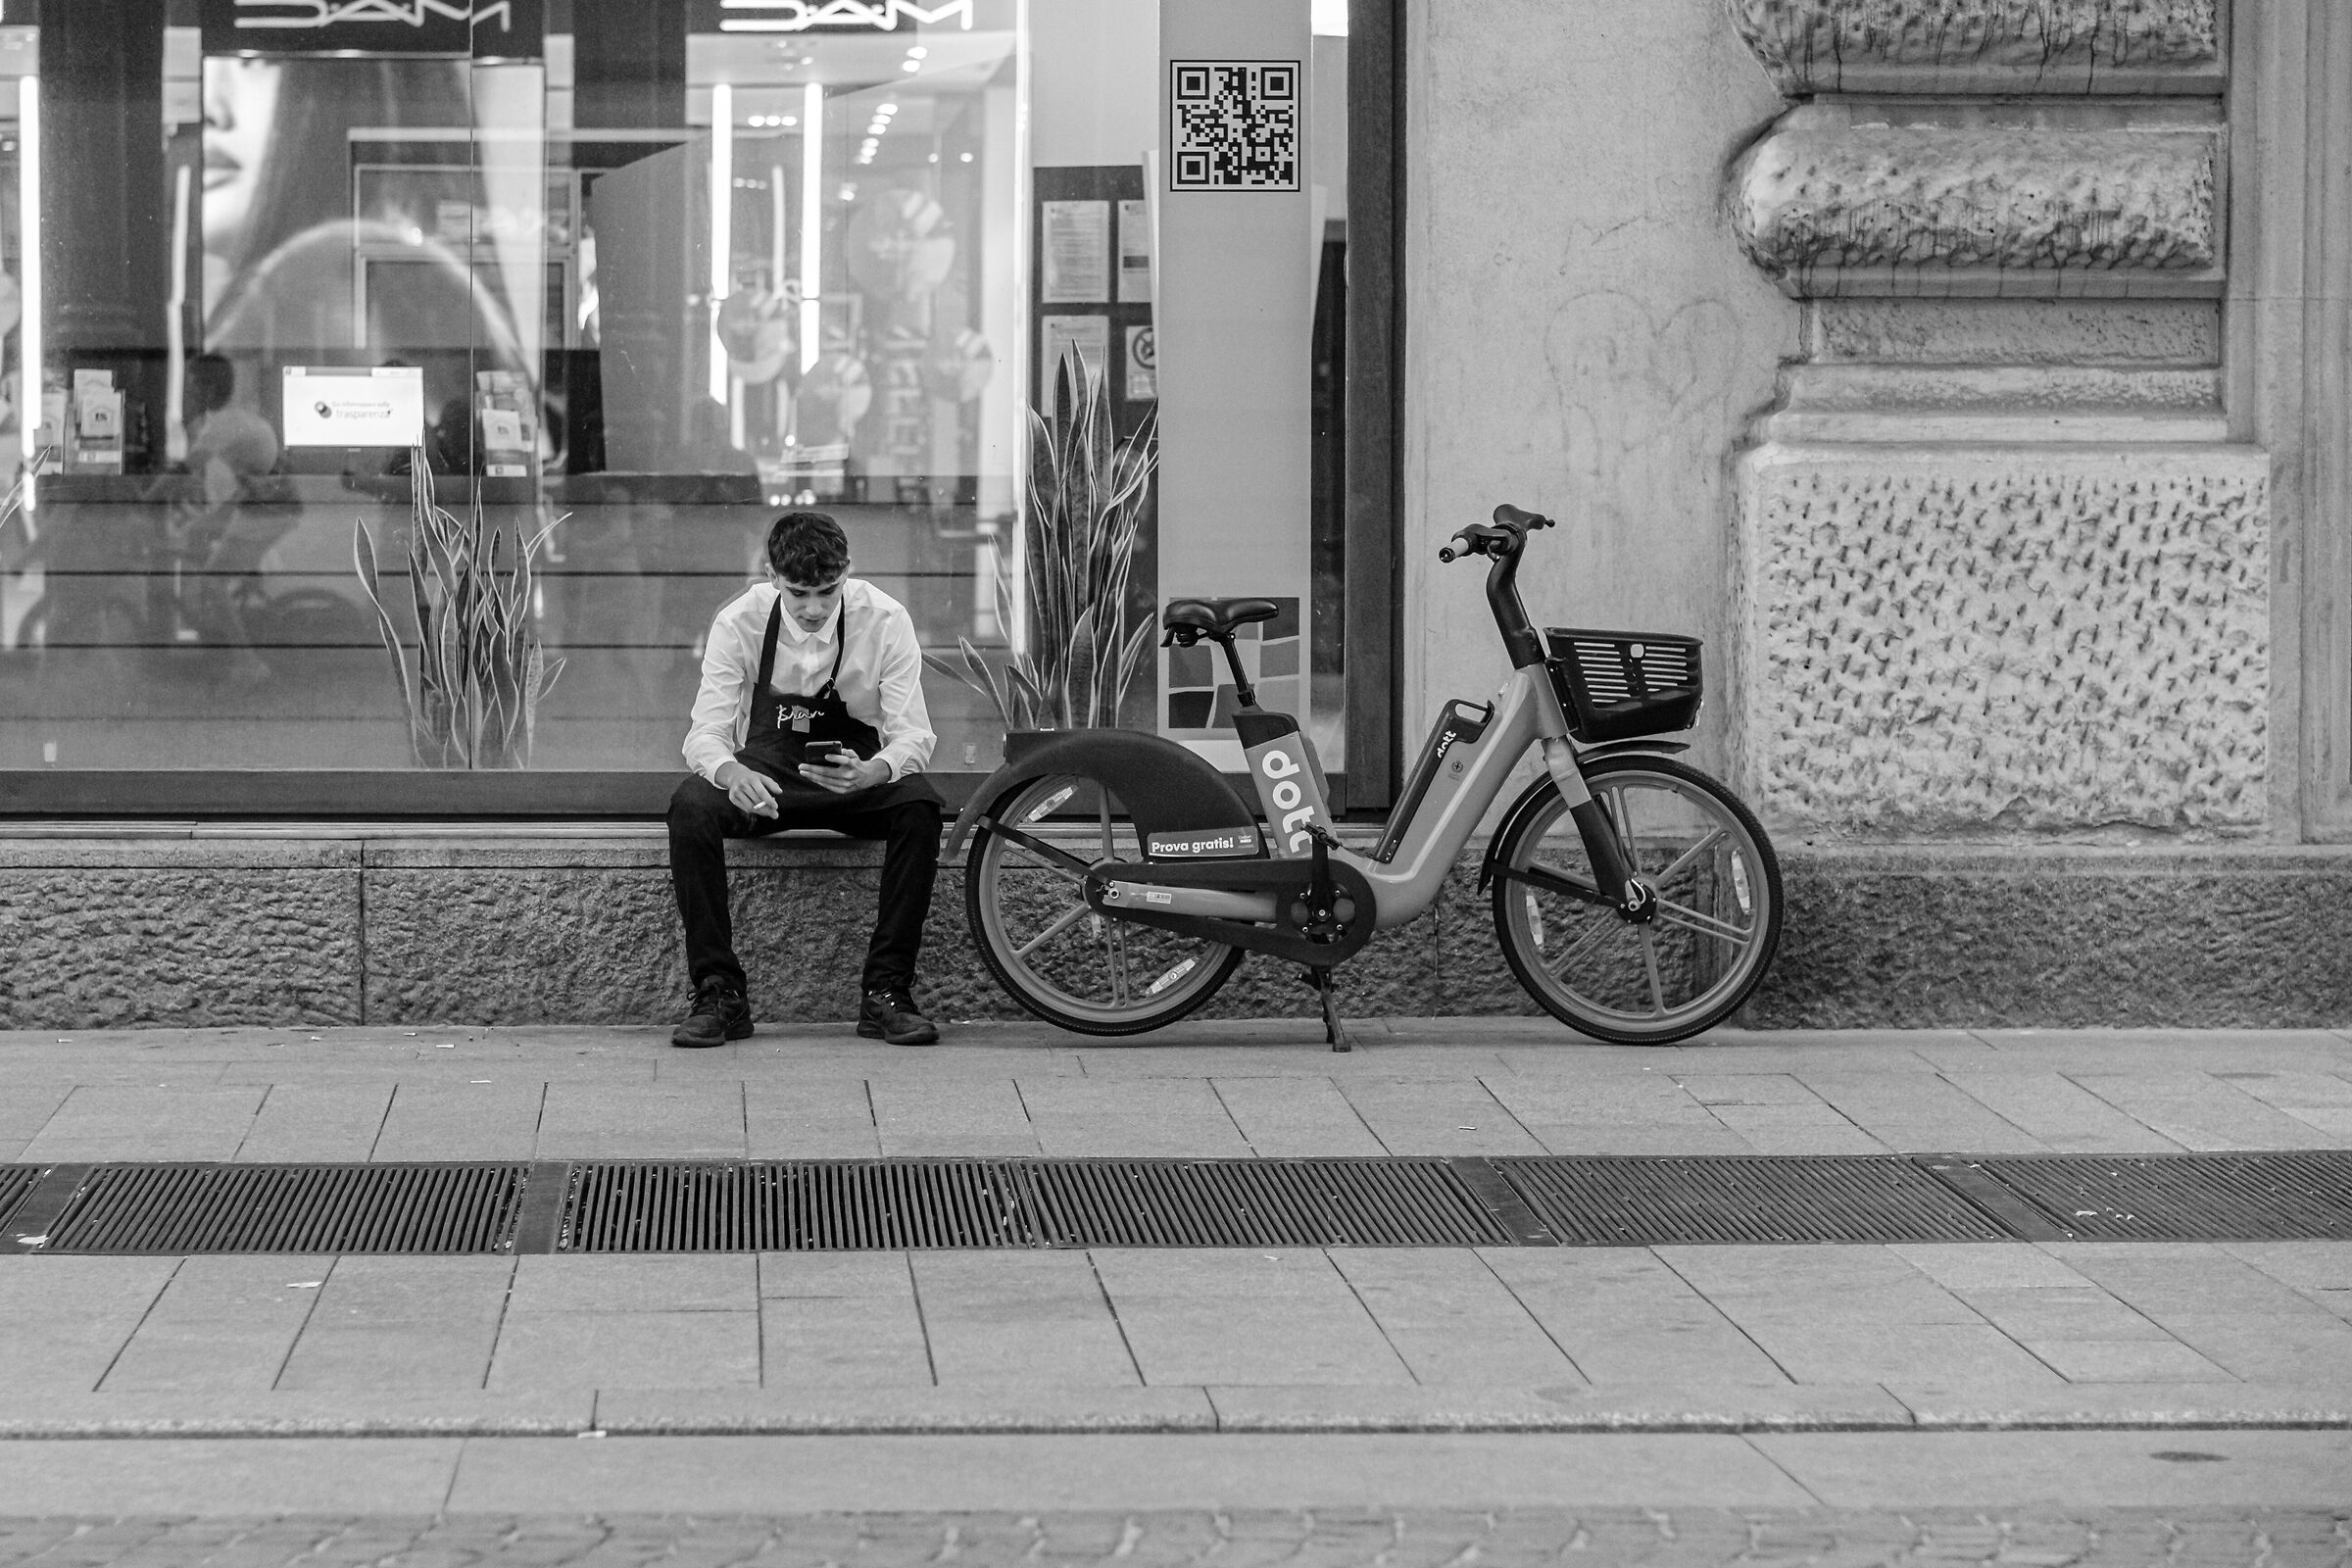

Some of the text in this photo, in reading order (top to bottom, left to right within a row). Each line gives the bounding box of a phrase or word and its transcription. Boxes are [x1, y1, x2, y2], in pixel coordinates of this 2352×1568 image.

[1437, 730, 1457, 759] dott
[1152, 837, 1234, 854] Prova gratis!
